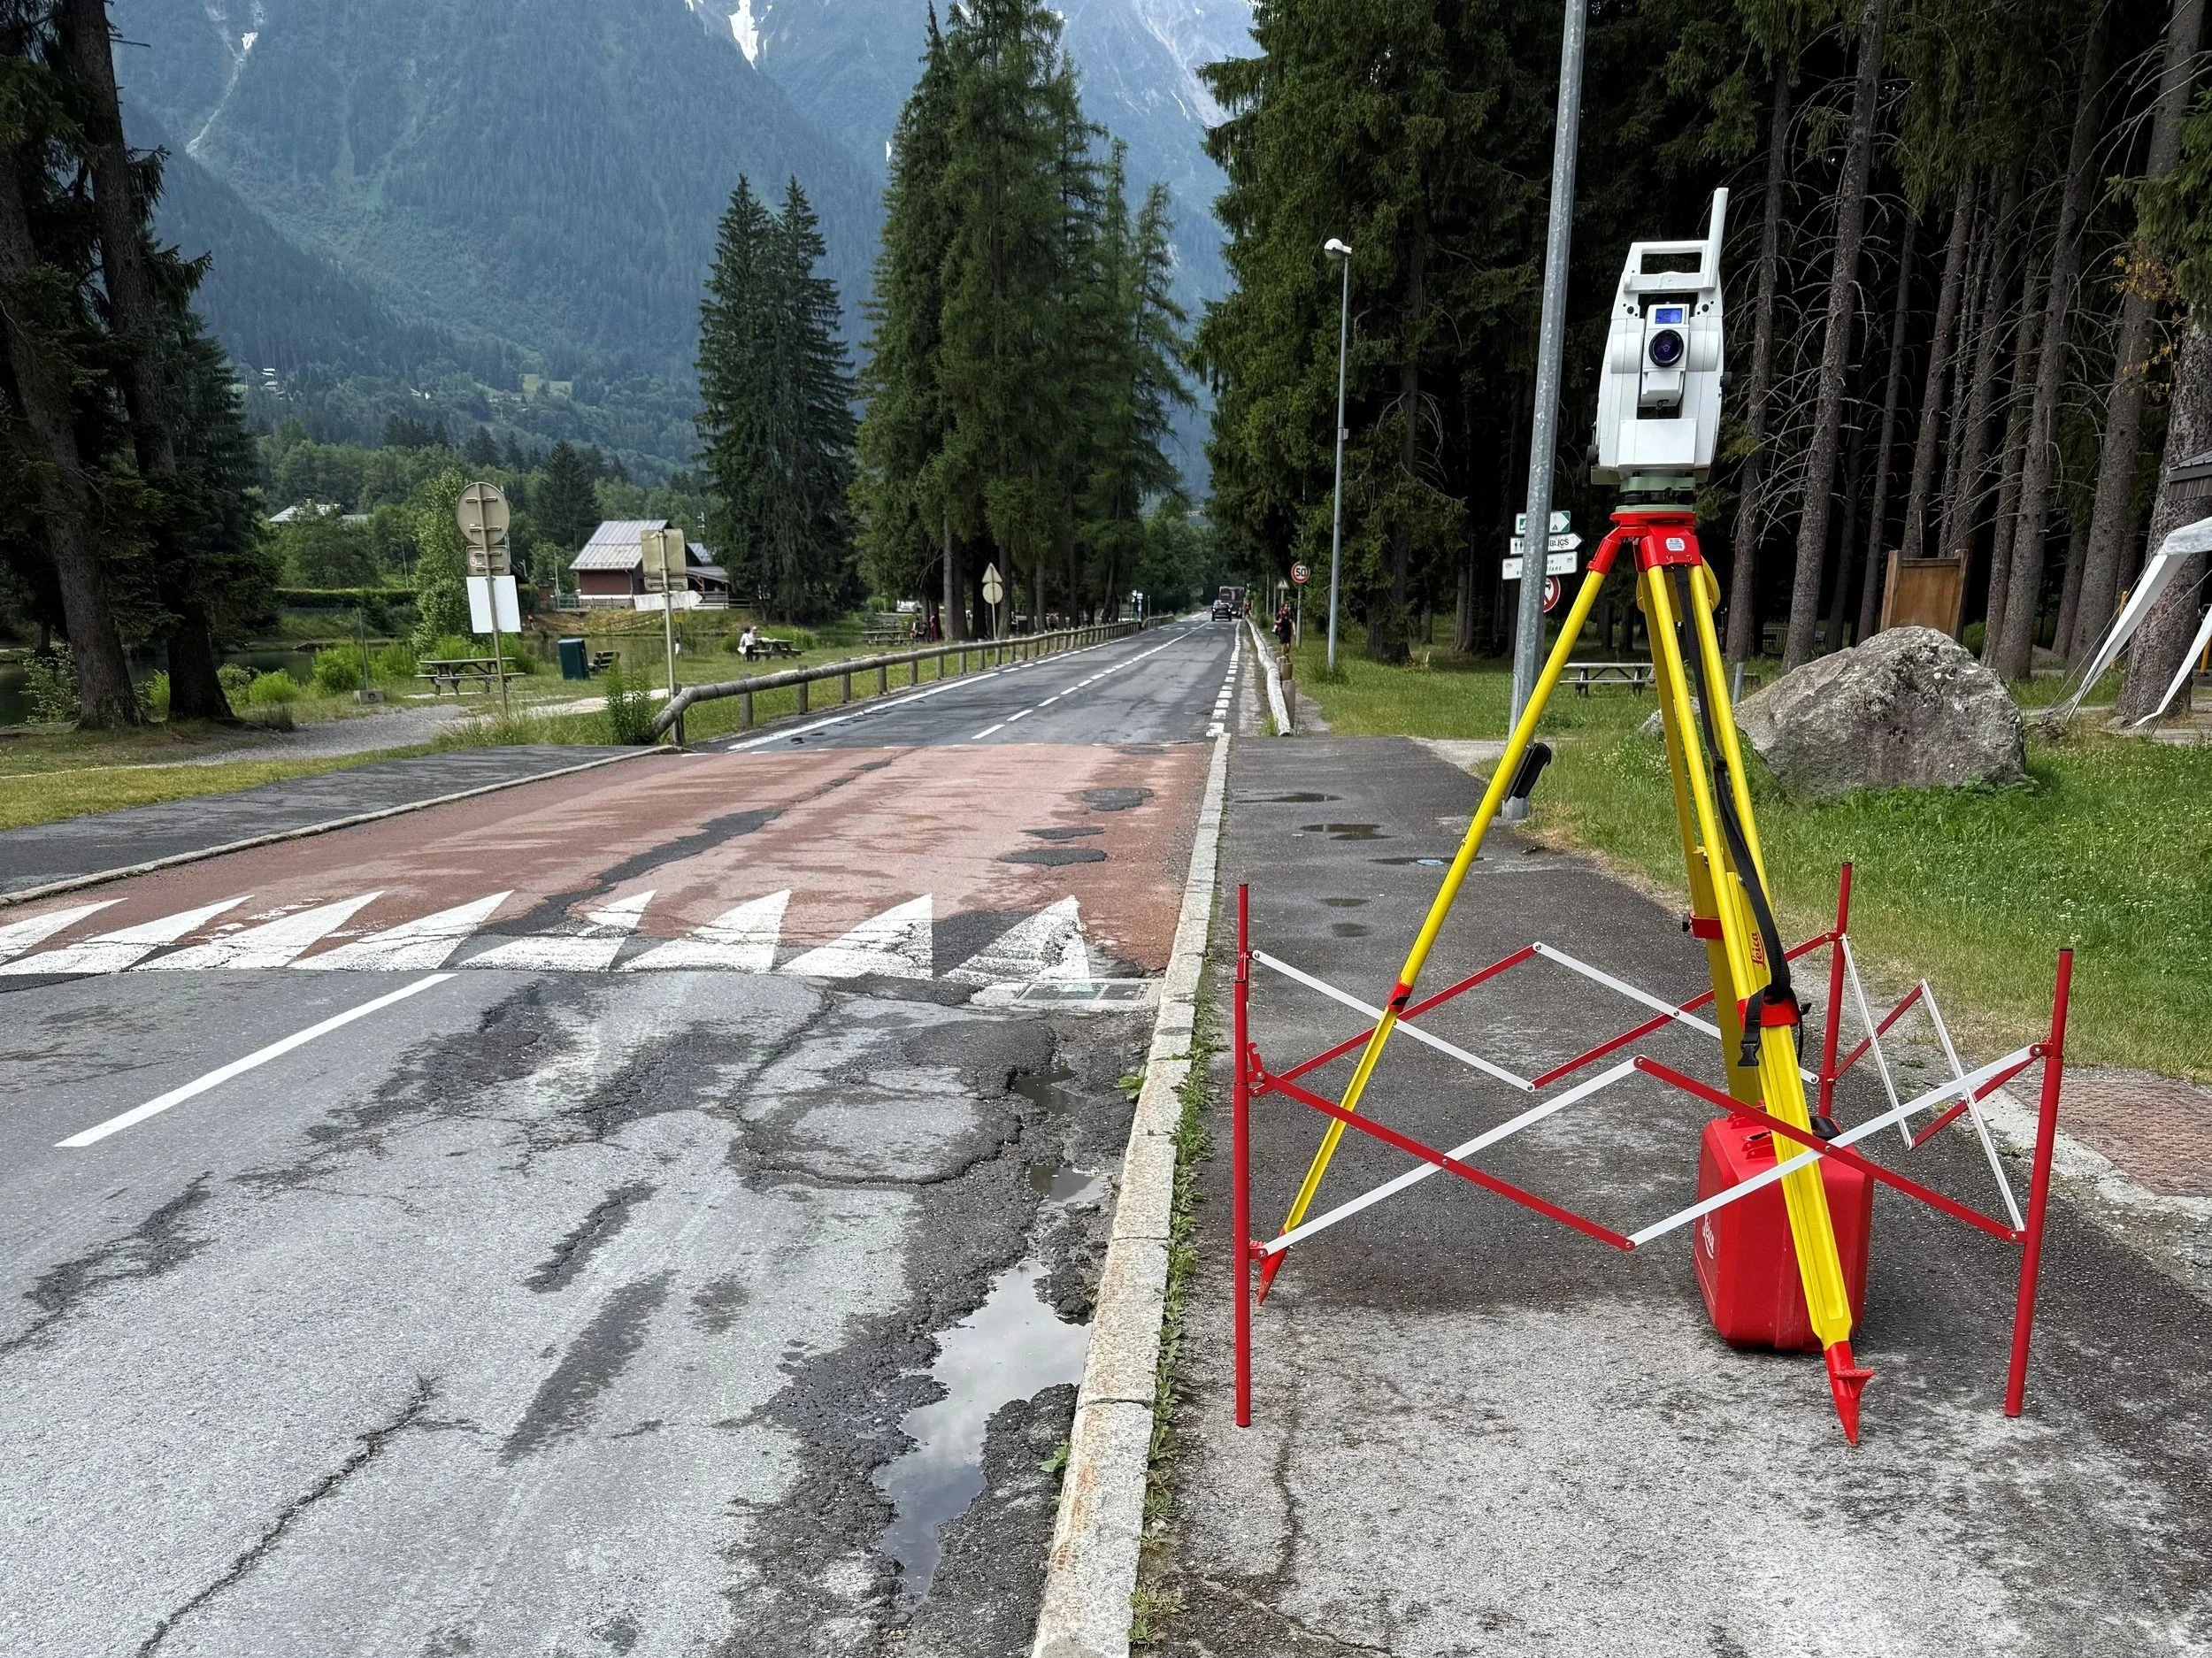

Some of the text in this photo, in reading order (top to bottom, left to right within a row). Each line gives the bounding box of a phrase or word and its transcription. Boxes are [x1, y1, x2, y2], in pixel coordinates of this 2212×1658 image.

[1549, 538, 1570, 547] BLICS
[1295, 567, 1306, 577] 50
[1751, 930, 1767, 971] Leica
[1701, 1213, 1715, 1260] Leica
